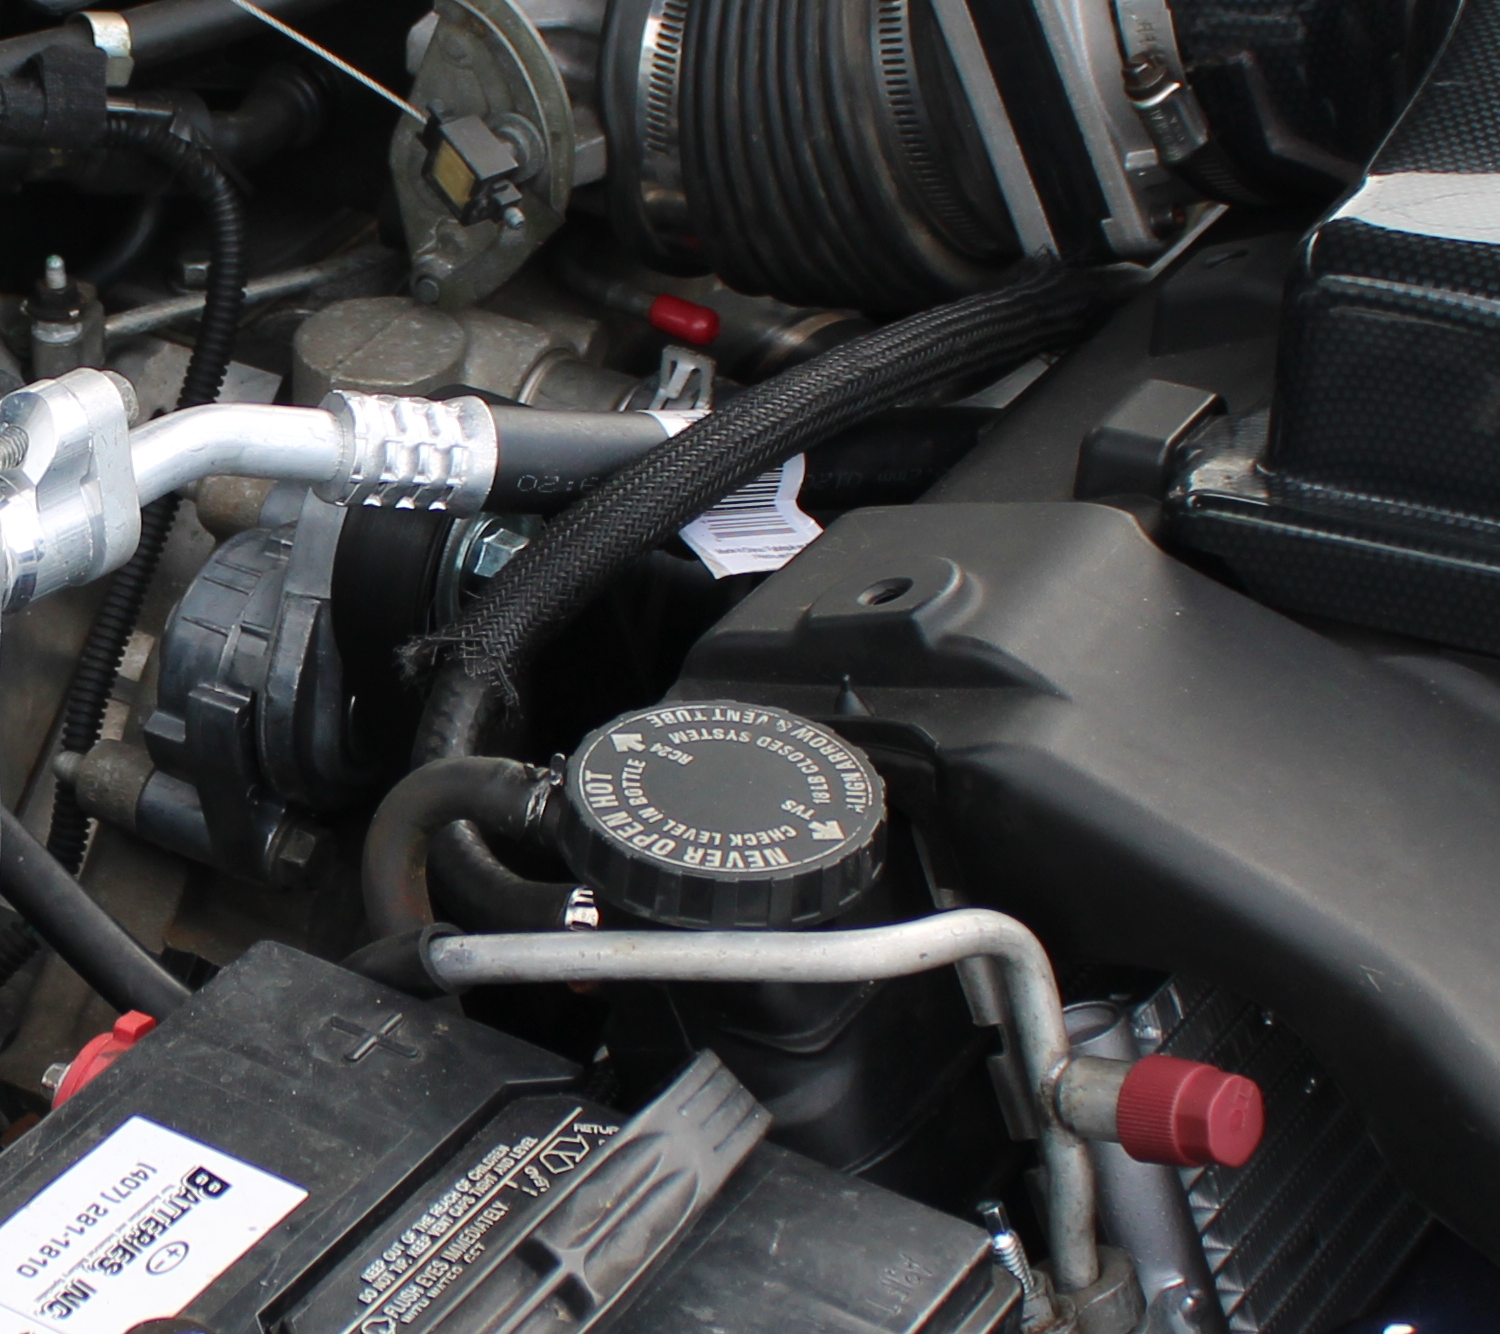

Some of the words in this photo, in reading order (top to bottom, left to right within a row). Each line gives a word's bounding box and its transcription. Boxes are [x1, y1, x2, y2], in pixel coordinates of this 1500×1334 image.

[646, 709, 708, 728] TUBE
[668, 728, 752, 745] SYSTEM
[711, 708, 770, 725] VENT
[650, 742, 694, 765] RC24
[756, 735, 819, 775] CLOSED
[790, 728, 857, 772] ARROW
[585, 769, 620, 809] HOT
[621, 758, 649, 806] BOTTLE
[637, 806, 665, 824] IN
[780, 799, 816, 821] TVS
[601, 810, 679, 857] OPEN
[662, 818, 723, 846] LEVEL
[729, 825, 798, 847] CHECK
[682, 847, 790, 869] NEVER
[100, 1161, 158, 1205] (407)
[358, 1286, 378, 1304] DO
[374, 1269, 396, 1291] NOT
[407, 1235, 432, 1258] KEEP
[428, 1214, 454, 1238] VENT
[449, 1195, 476, 1218] CAPS
[472, 1174, 499, 1198] TIGHT
[494, 1156, 516, 1177] AND
[510, 1136, 539, 1161] LEVEL
[361, 1259, 387, 1284] KEEP
[383, 1241, 406, 1263] OUT
[401, 1228, 417, 1244] OF
[412, 1213, 435, 1234] THE
[430, 1189, 462, 1218] REACH
[455, 1176, 472, 1193] OF
[467, 1144, 511, 1181] CHILDREN
[16, 1202, 108, 1279] 281-1810
[383, 1281, 425, 1320] FLUSH
[415, 1258, 450, 1288] EYES
[441, 1199, 510, 1264] IMMEDIATELY
